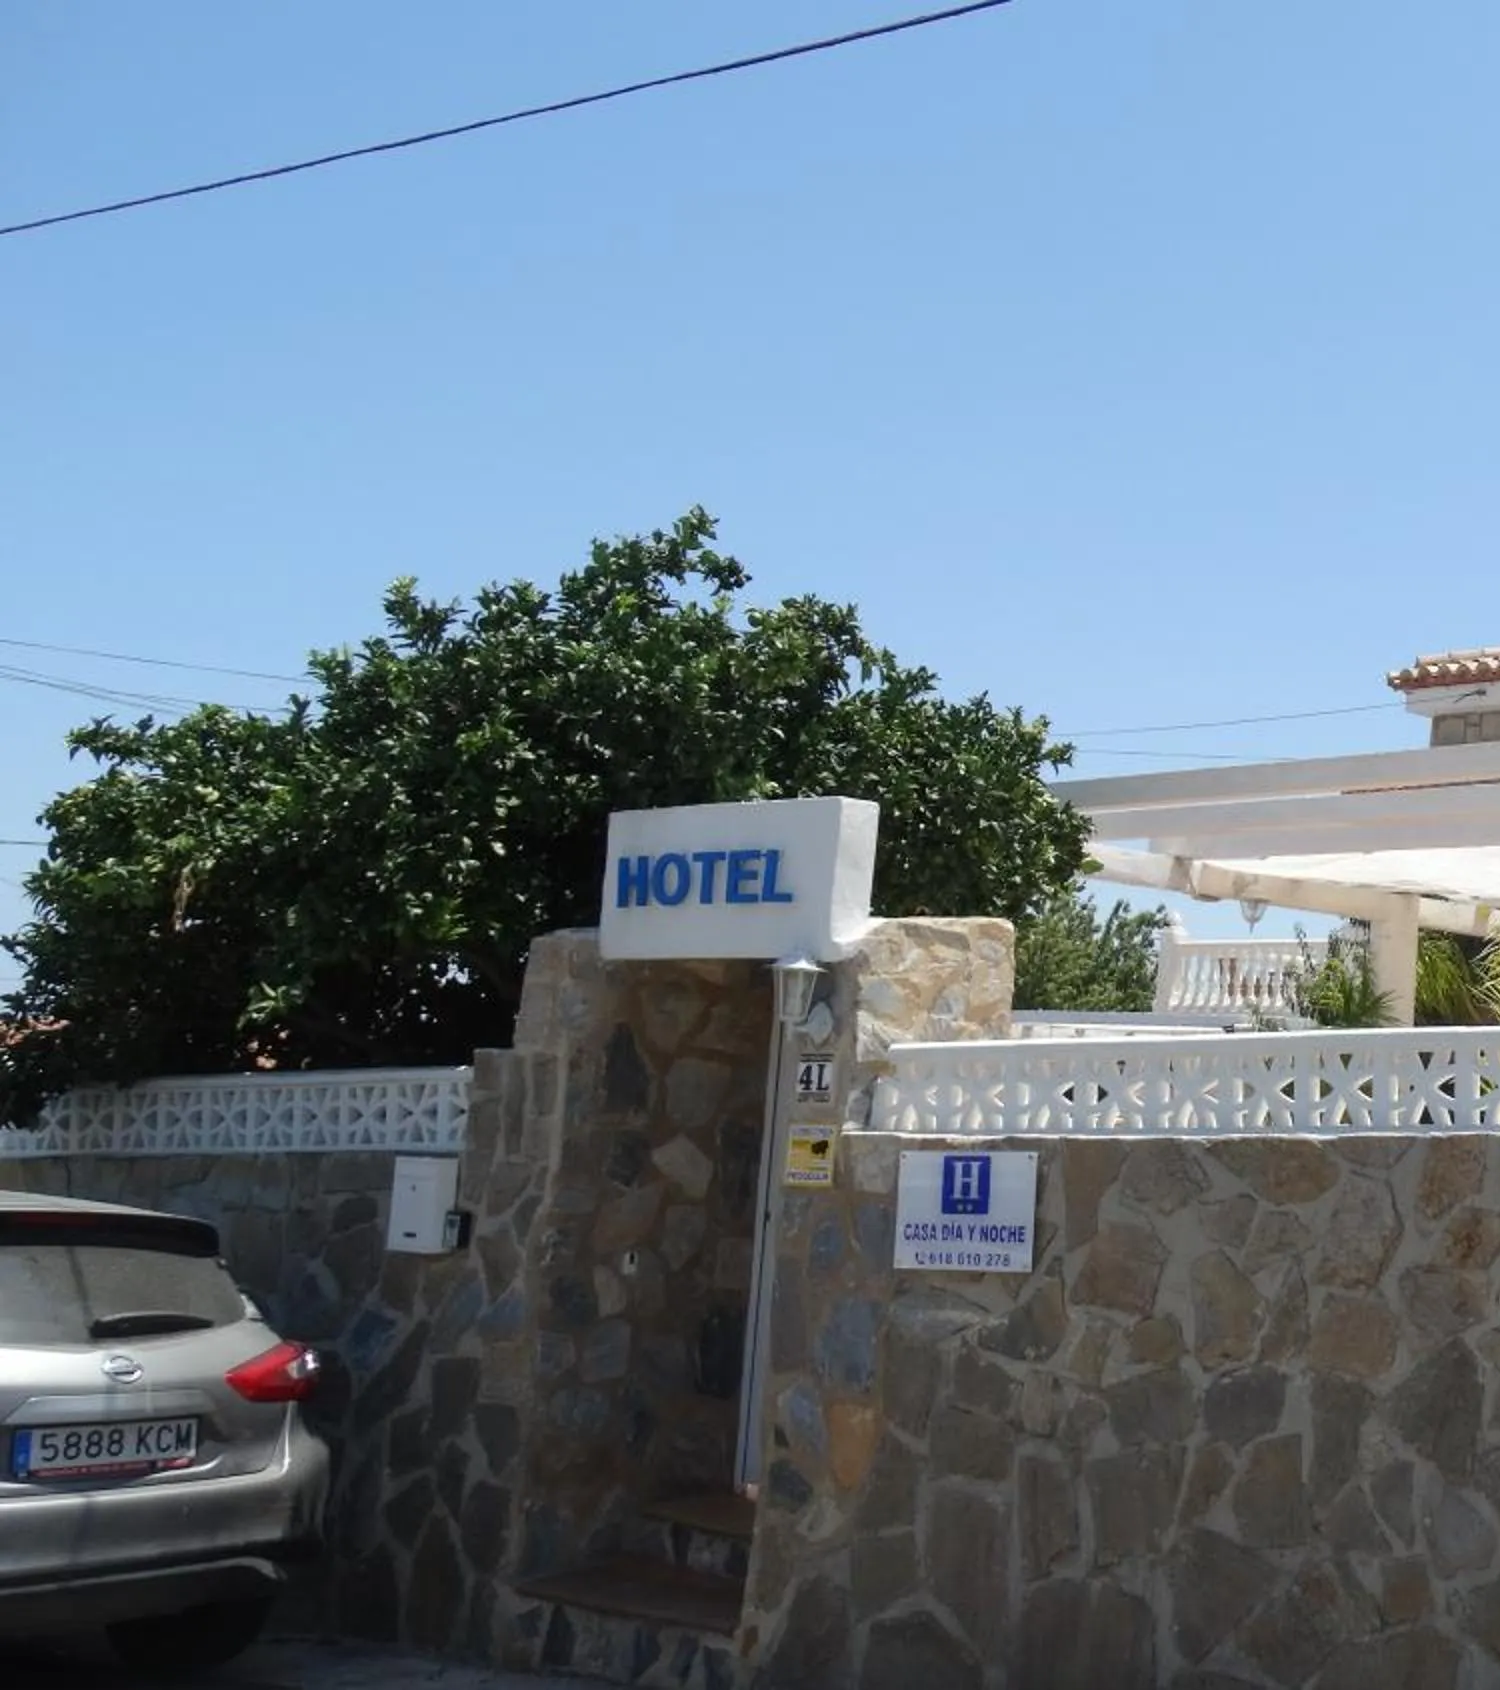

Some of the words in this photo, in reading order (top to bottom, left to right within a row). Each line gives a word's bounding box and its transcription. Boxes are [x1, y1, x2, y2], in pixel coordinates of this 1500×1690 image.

[616, 849, 793, 908] HOTEL
[952, 1161, 982, 1200] H
[903, 1223, 937, 1241] CASA
[967, 1223, 977, 1241] Y
[979, 1223, 1026, 1243] NOCHE
[40, 1428, 125, 1462] 5888
[135, 1423, 192, 1455] KCM
